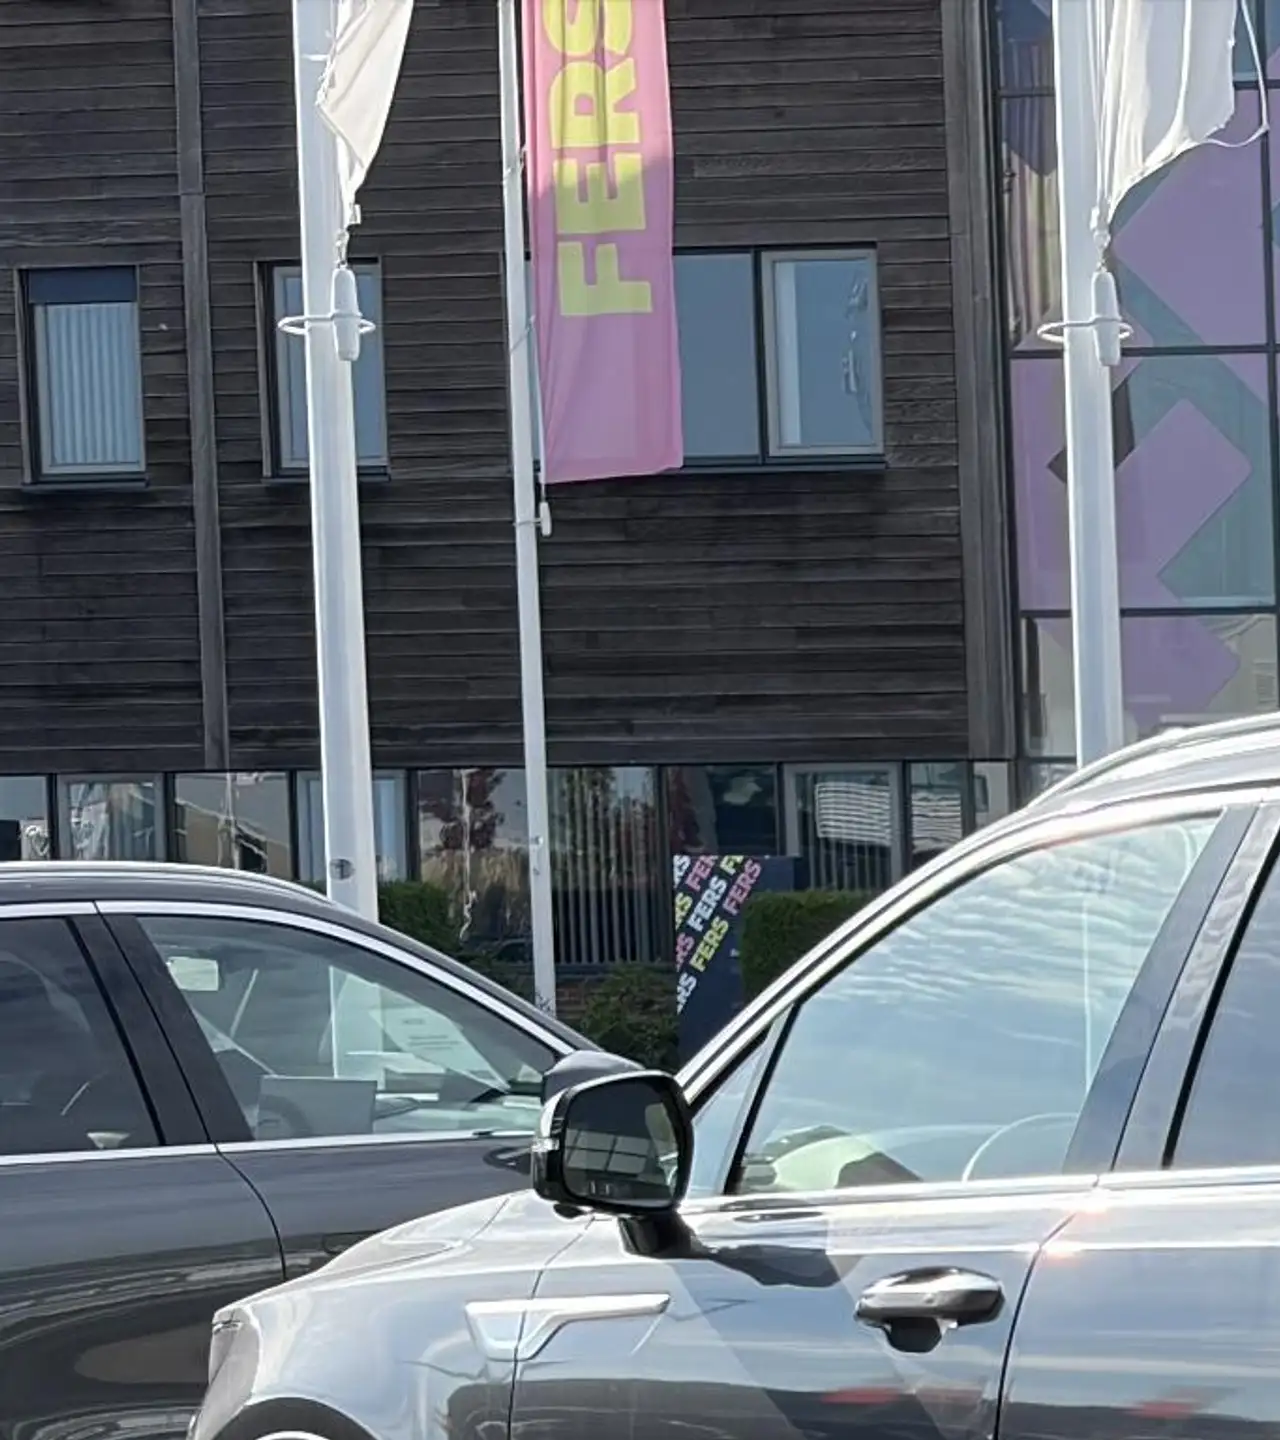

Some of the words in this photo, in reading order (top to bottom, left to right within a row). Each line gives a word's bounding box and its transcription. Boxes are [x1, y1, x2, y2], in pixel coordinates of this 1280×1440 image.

[542, 0, 654, 317] FERS
[687, 875, 728, 932] FERS
[721, 858, 762, 916] FERS
[689, 916, 729, 972] FERS
